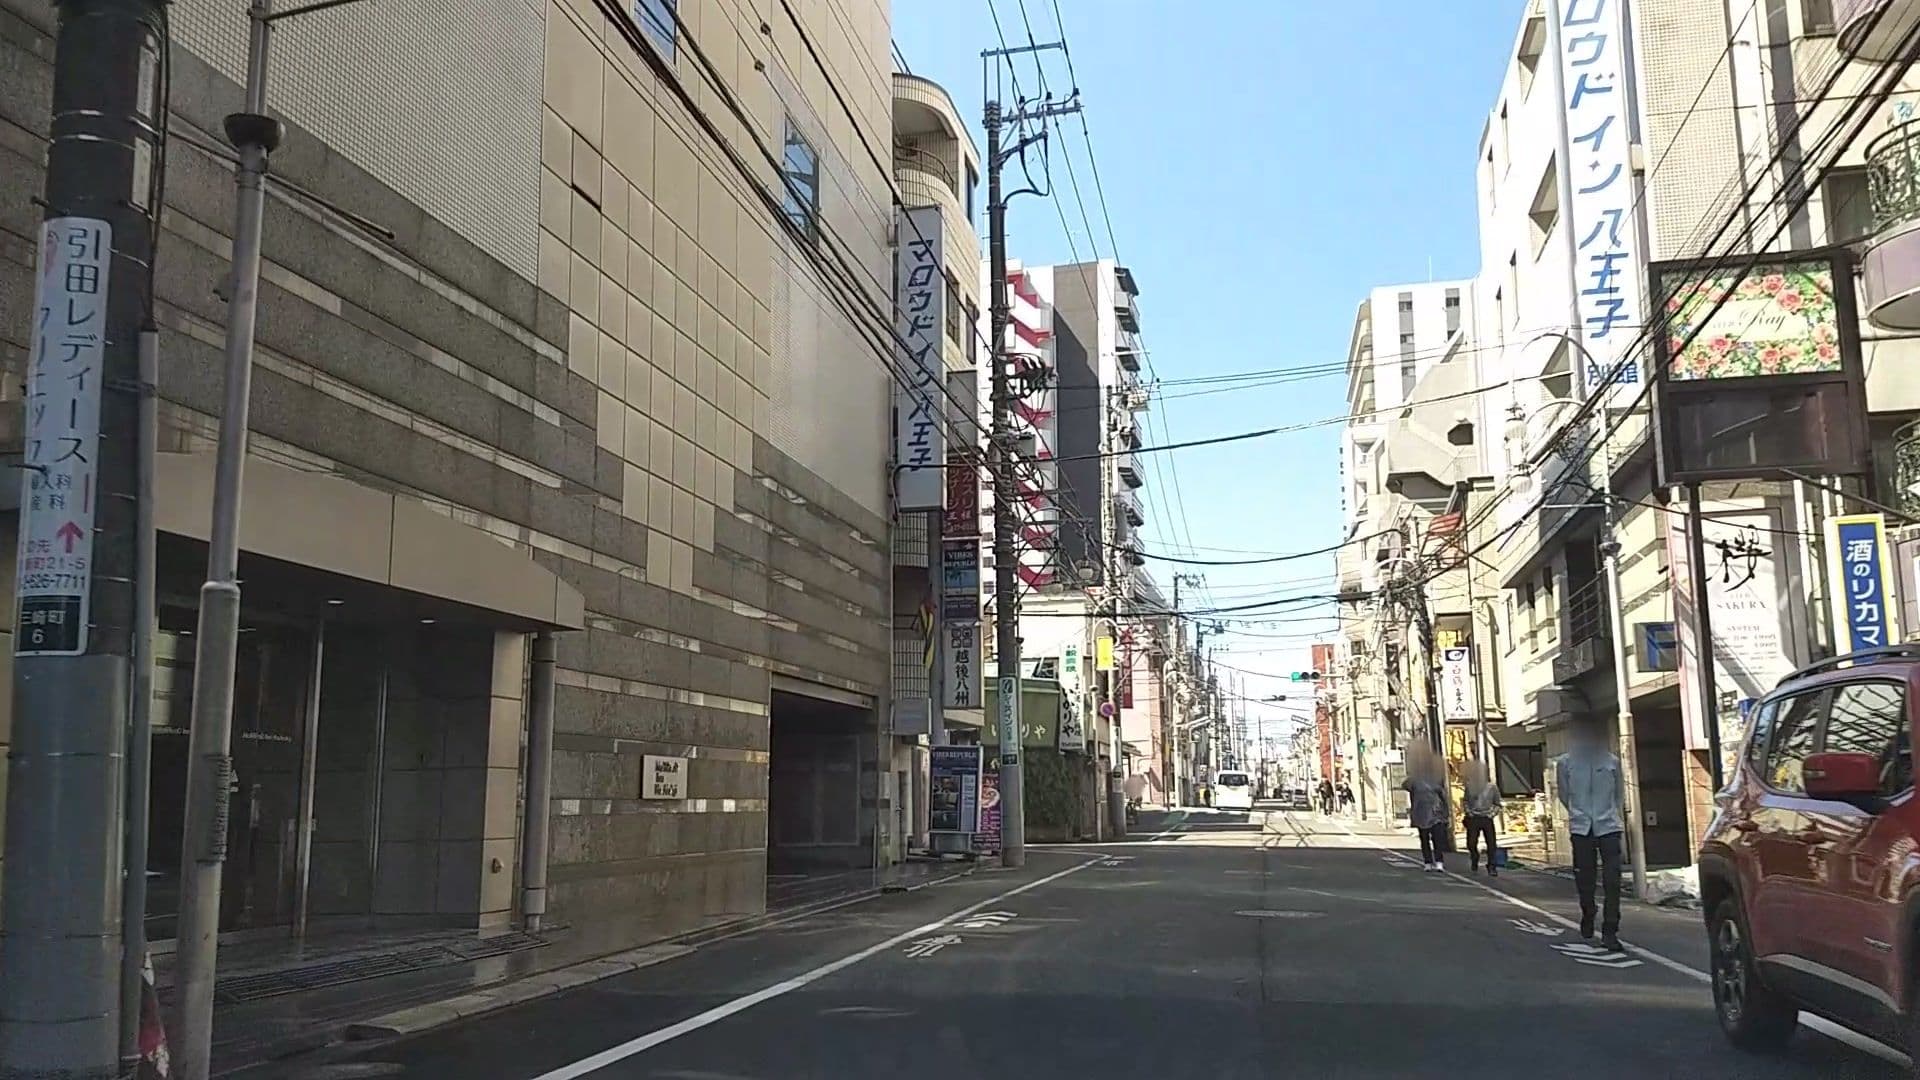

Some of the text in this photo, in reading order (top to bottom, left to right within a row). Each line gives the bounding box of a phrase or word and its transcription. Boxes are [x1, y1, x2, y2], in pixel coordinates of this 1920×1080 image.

[55, 227, 100, 464] 引田レディース
[907, 239, 934, 472] マロウドイン八王子
[31, 627, 44, 644] 6
